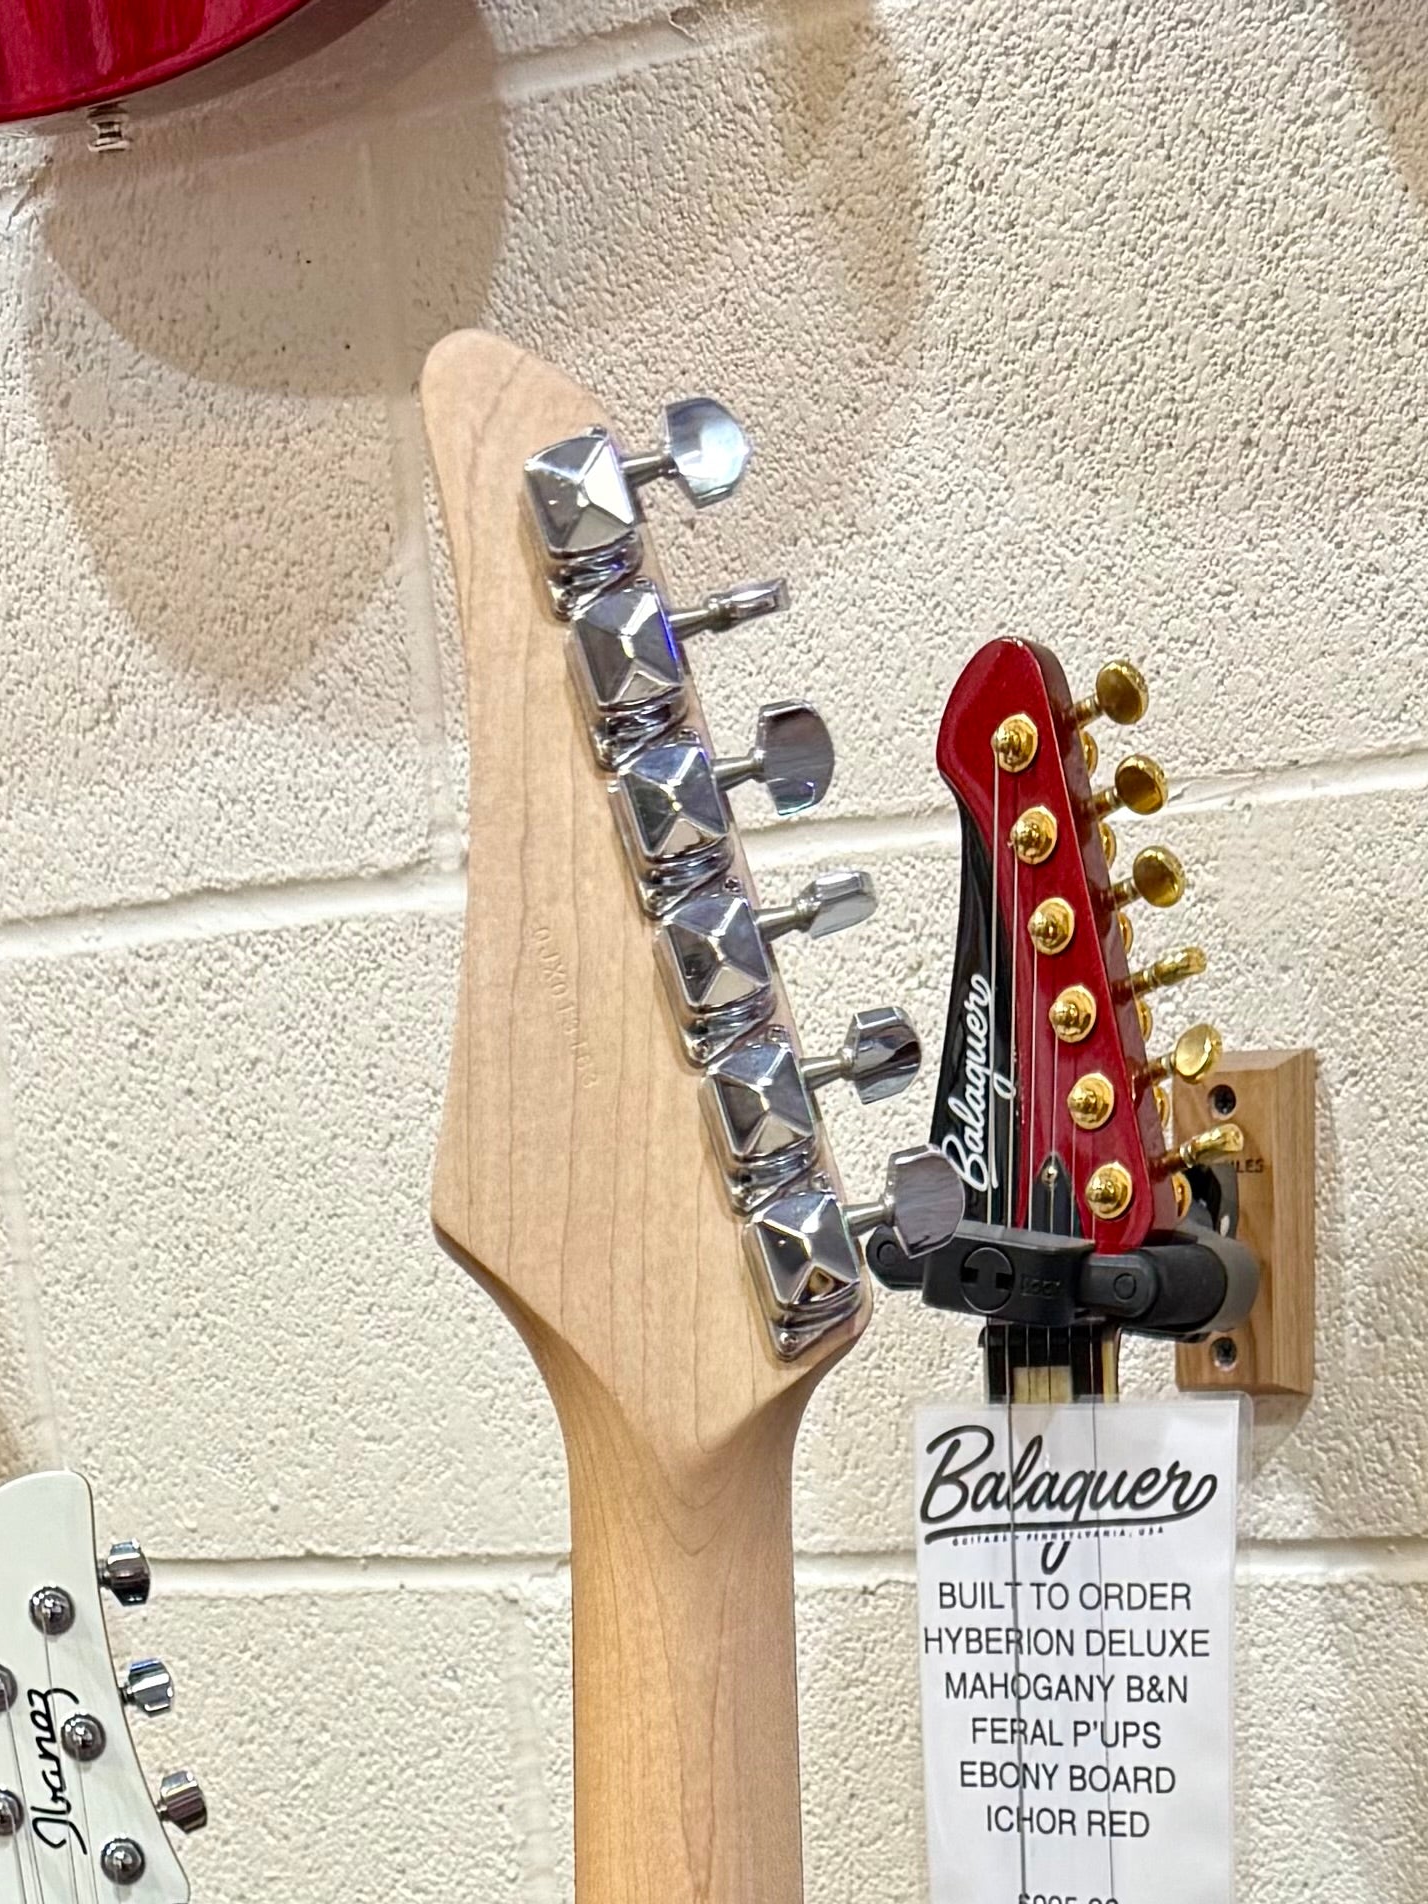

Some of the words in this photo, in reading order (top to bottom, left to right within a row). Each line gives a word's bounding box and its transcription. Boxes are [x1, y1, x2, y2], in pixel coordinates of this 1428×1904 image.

[943, 973, 1016, 1193] Balaguer
[920, 1424, 1217, 1574] Balaguer
[939, 1582, 1021, 1610] BUILT
[1031, 1582, 1069, 1610] TO
[1079, 1583, 1190, 1611] ORDER
[924, 1628, 1073, 1656] HYBERION
[1085, 1629, 1209, 1657] DELUXE
[944, 1673, 1114, 1703] MAHOGANY
[1127, 1675, 1187, 1703] B&N
[972, 1717, 1063, 1746] FERAL
[1073, 1720, 1161, 1749] P'UPS
[27, 1687, 88, 1855] Ibanez
[960, 1762, 1058, 1791] EBONY
[1070, 1765, 1176, 1794] BOARD
[987, 1805, 1076, 1836] ICHOR
[1087, 1808, 1150, 1838] RED
